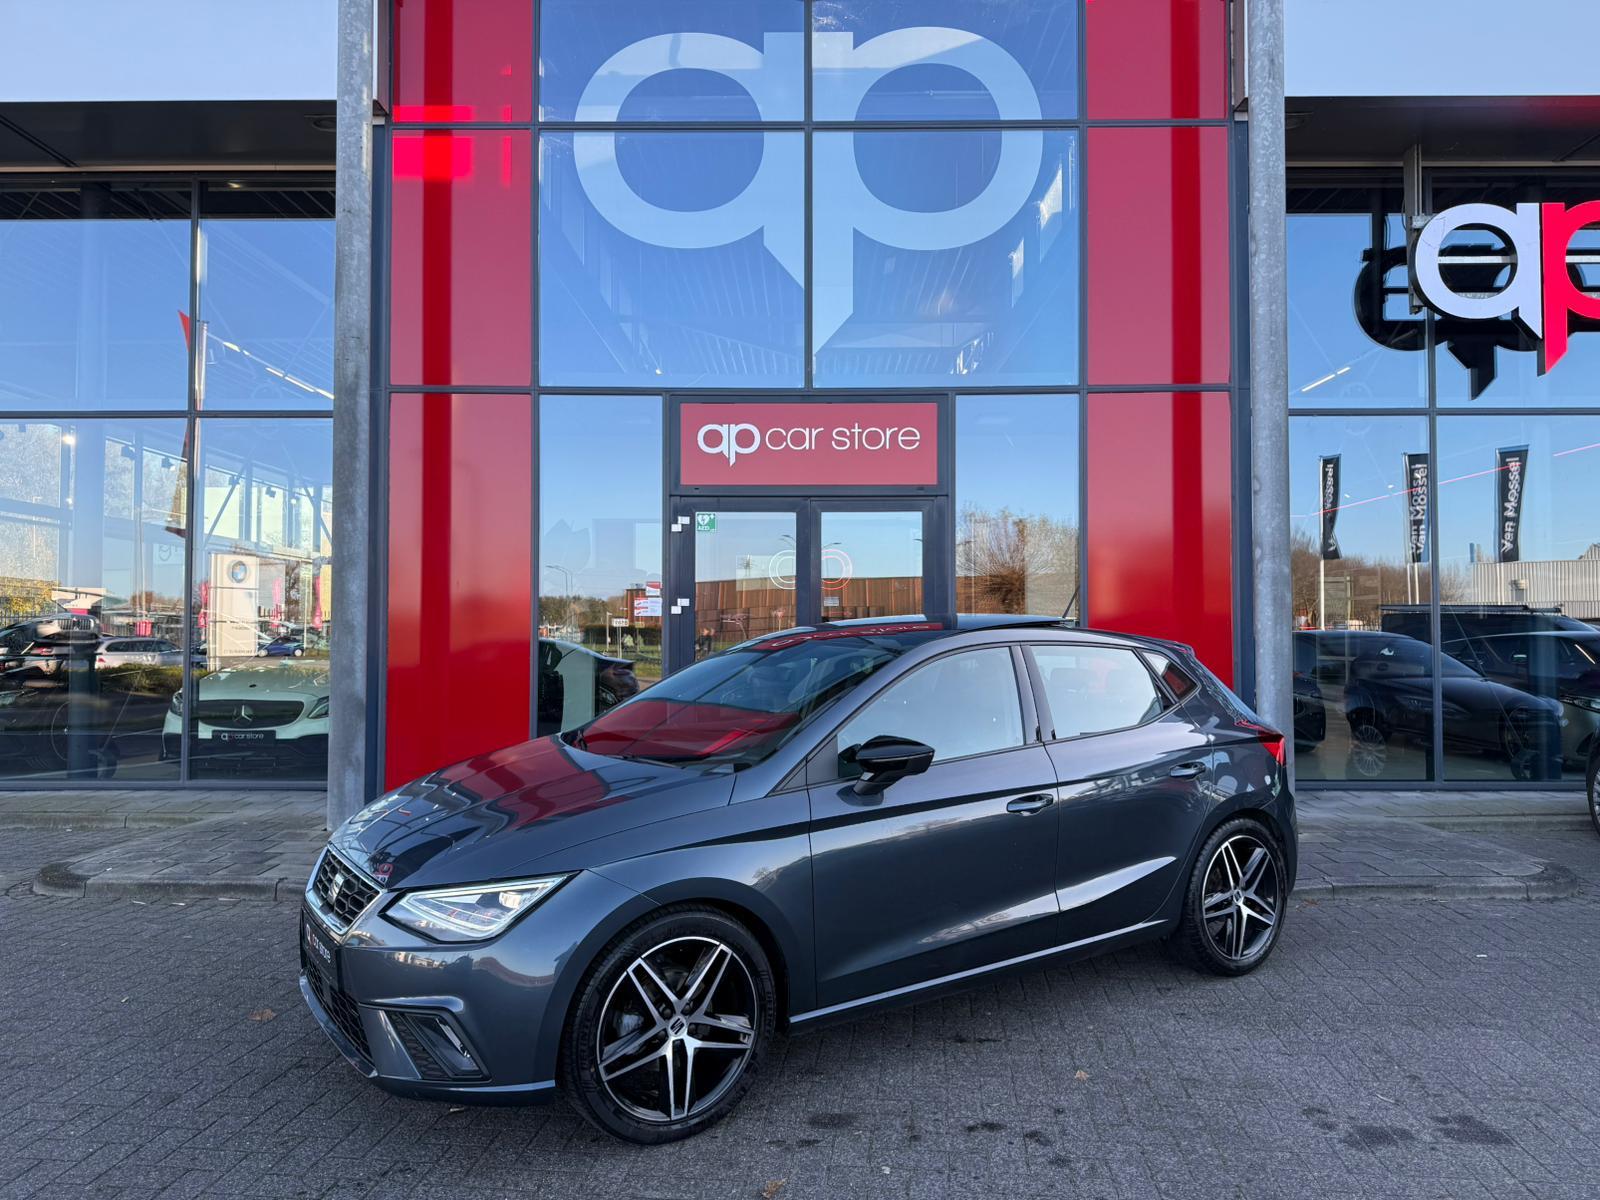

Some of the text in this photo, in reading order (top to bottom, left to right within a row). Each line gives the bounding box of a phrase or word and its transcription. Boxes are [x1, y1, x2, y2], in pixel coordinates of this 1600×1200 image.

[697, 422, 921, 467] ap car store
